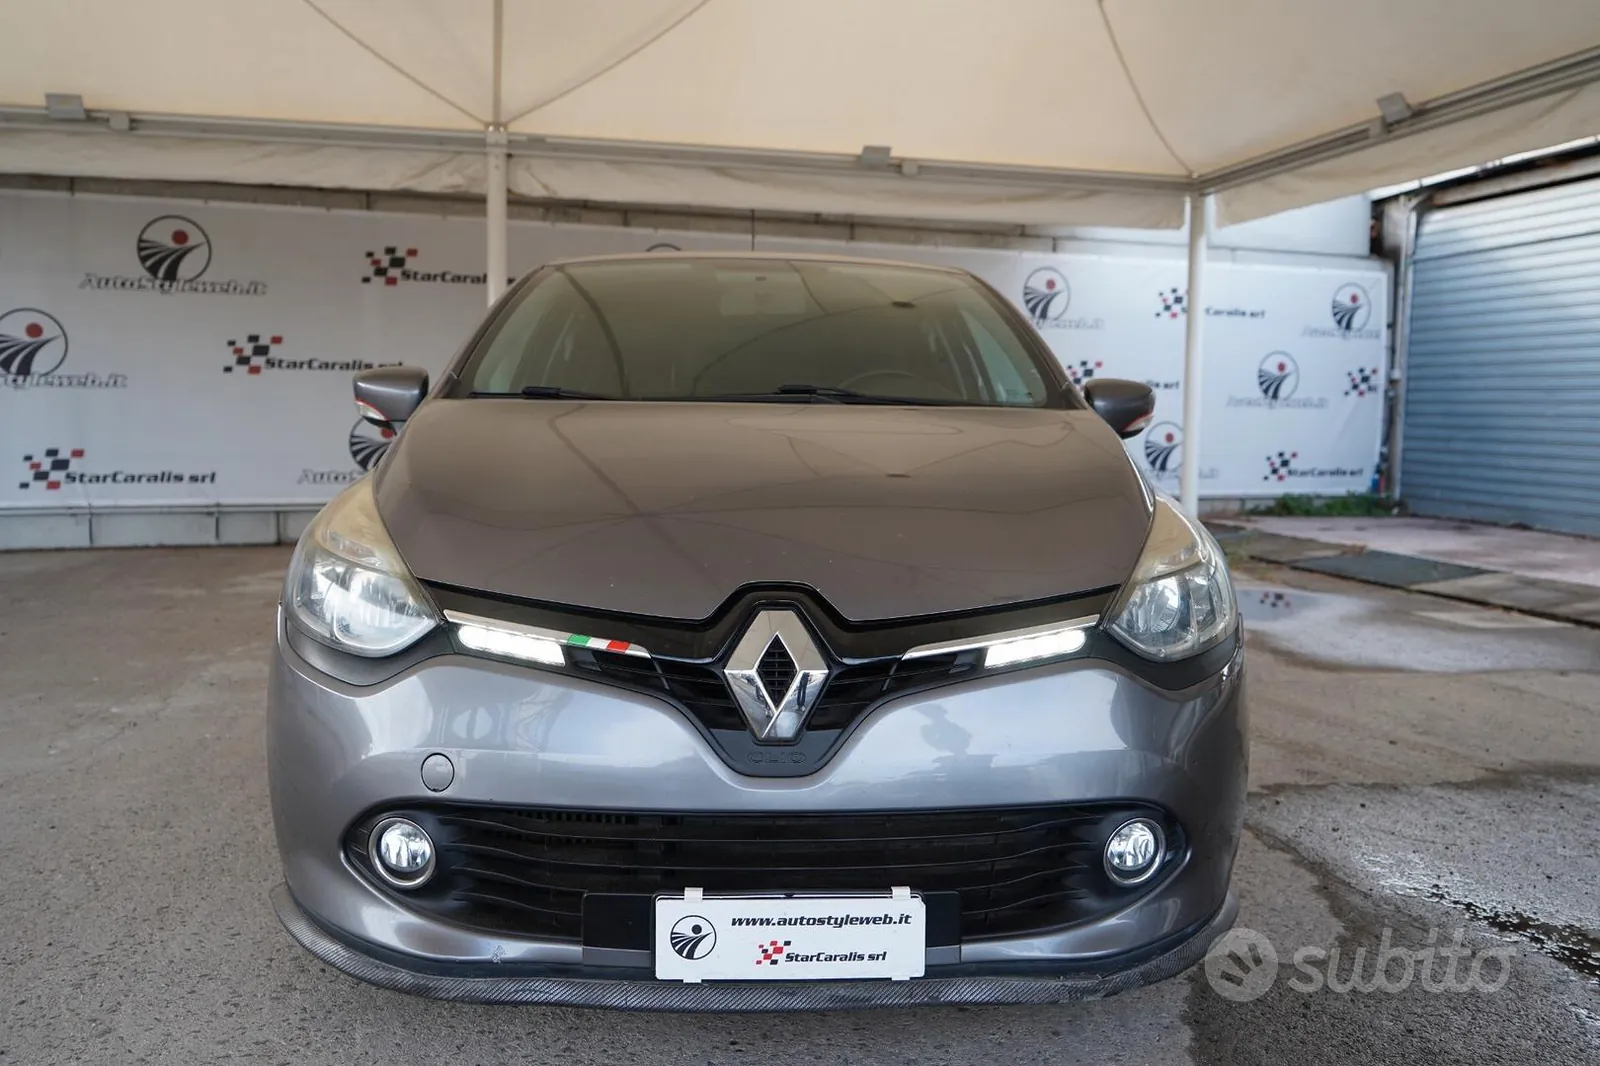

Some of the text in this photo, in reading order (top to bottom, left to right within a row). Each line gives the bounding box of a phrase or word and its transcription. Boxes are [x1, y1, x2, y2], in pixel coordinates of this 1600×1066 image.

[64, 470, 217, 485] StarCaralis srl
[747, 750, 807, 764] CLIO
[730, 913, 912, 928] www.autostyleweb.it
[784, 951, 887, 963] StarCaralis srl
